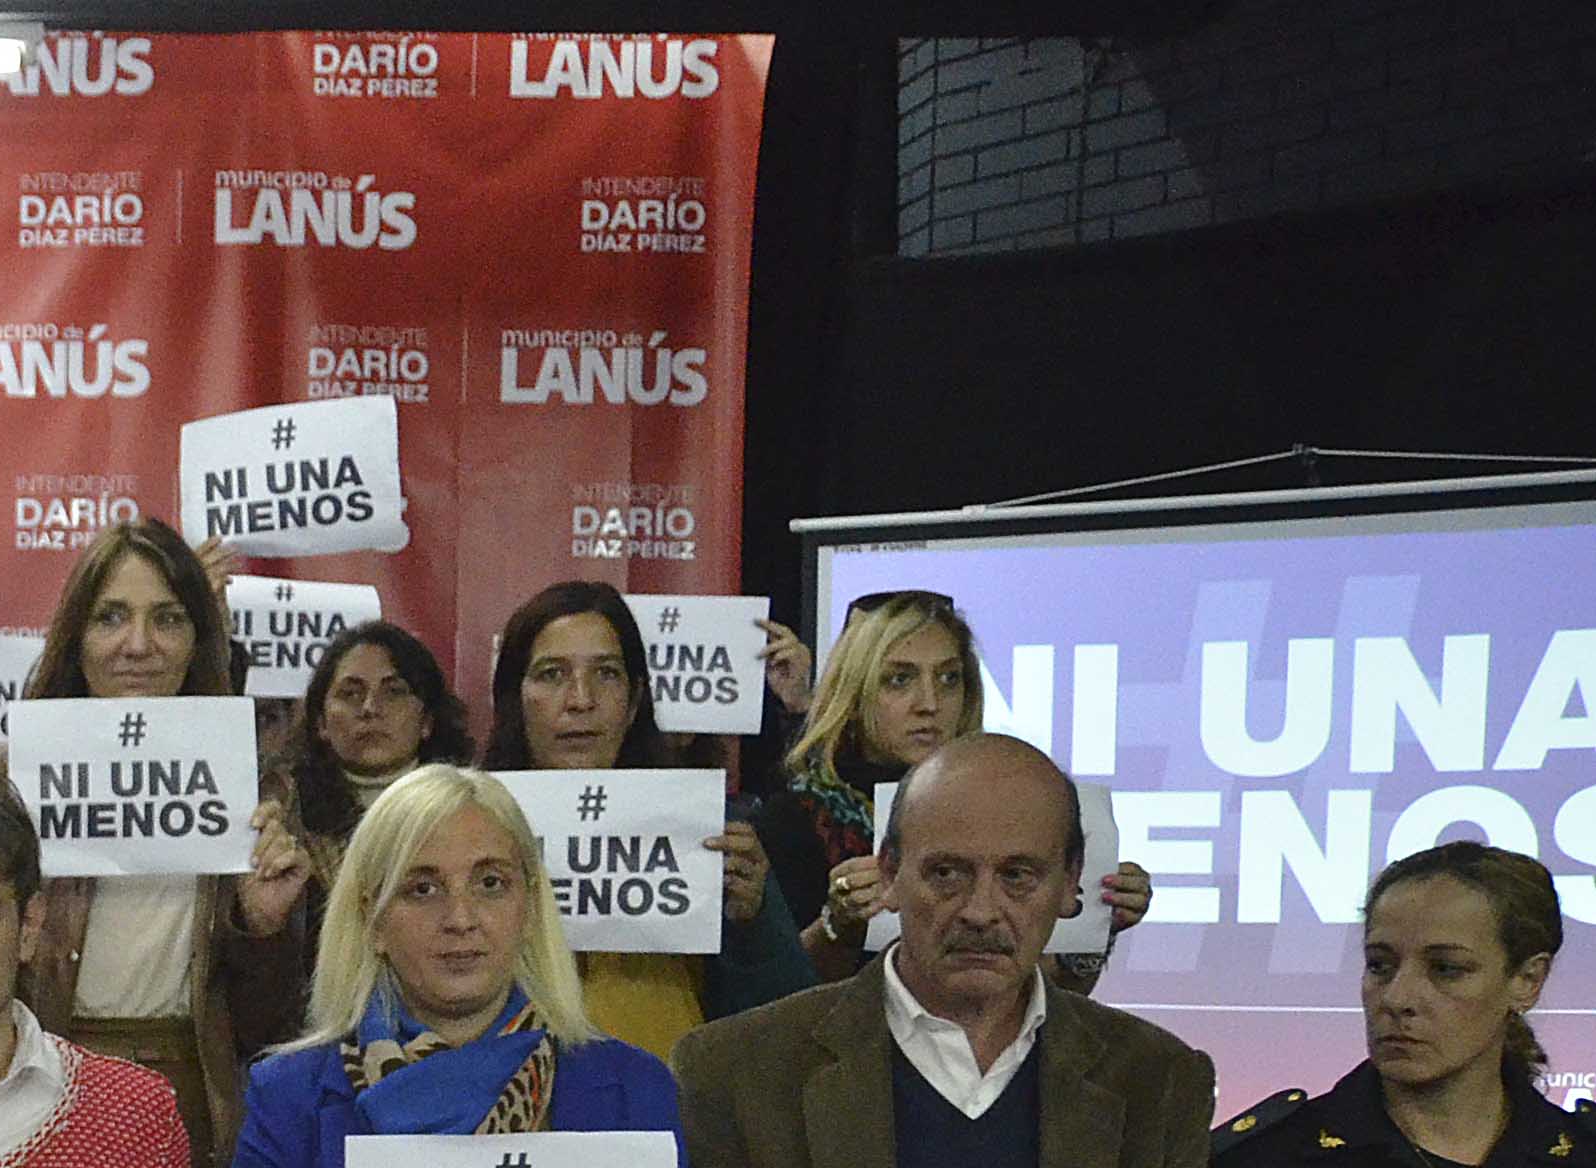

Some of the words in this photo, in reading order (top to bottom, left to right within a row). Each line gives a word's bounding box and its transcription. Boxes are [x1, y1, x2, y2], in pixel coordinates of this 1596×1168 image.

[313, 38, 438, 76] DARÍO
[215, 171, 329, 189] municipio
[20, 189, 144, 226] DARÍO
[215, 174, 418, 249] LANÚS
[581, 193, 706, 230] DARÍO
[502, 329, 617, 348] municipio
[308, 345, 429, 382] DARÍO
[500, 330, 708, 407] LANÚS
[272, 419, 297, 450] #
[206, 470, 248, 501] NI
[266, 455, 364, 494] UNA
[15, 492, 140, 528] DARÍO
[206, 491, 376, 538] MENOS
[572, 503, 696, 538] DARÍO
[275, 584, 295, 604] #
[269, 610, 349, 638] UNA
[658, 606, 683, 634] #
[648, 643, 734, 674] UNA
[983, 643, 1119, 776] NI
[118, 712, 148, 748] #
[39, 762, 90, 800] NI
[110, 760, 220, 798] UNA
[39, 800, 231, 841] MENOS
[577, 785, 608, 822] #
[566, 835, 681, 875] UNA
